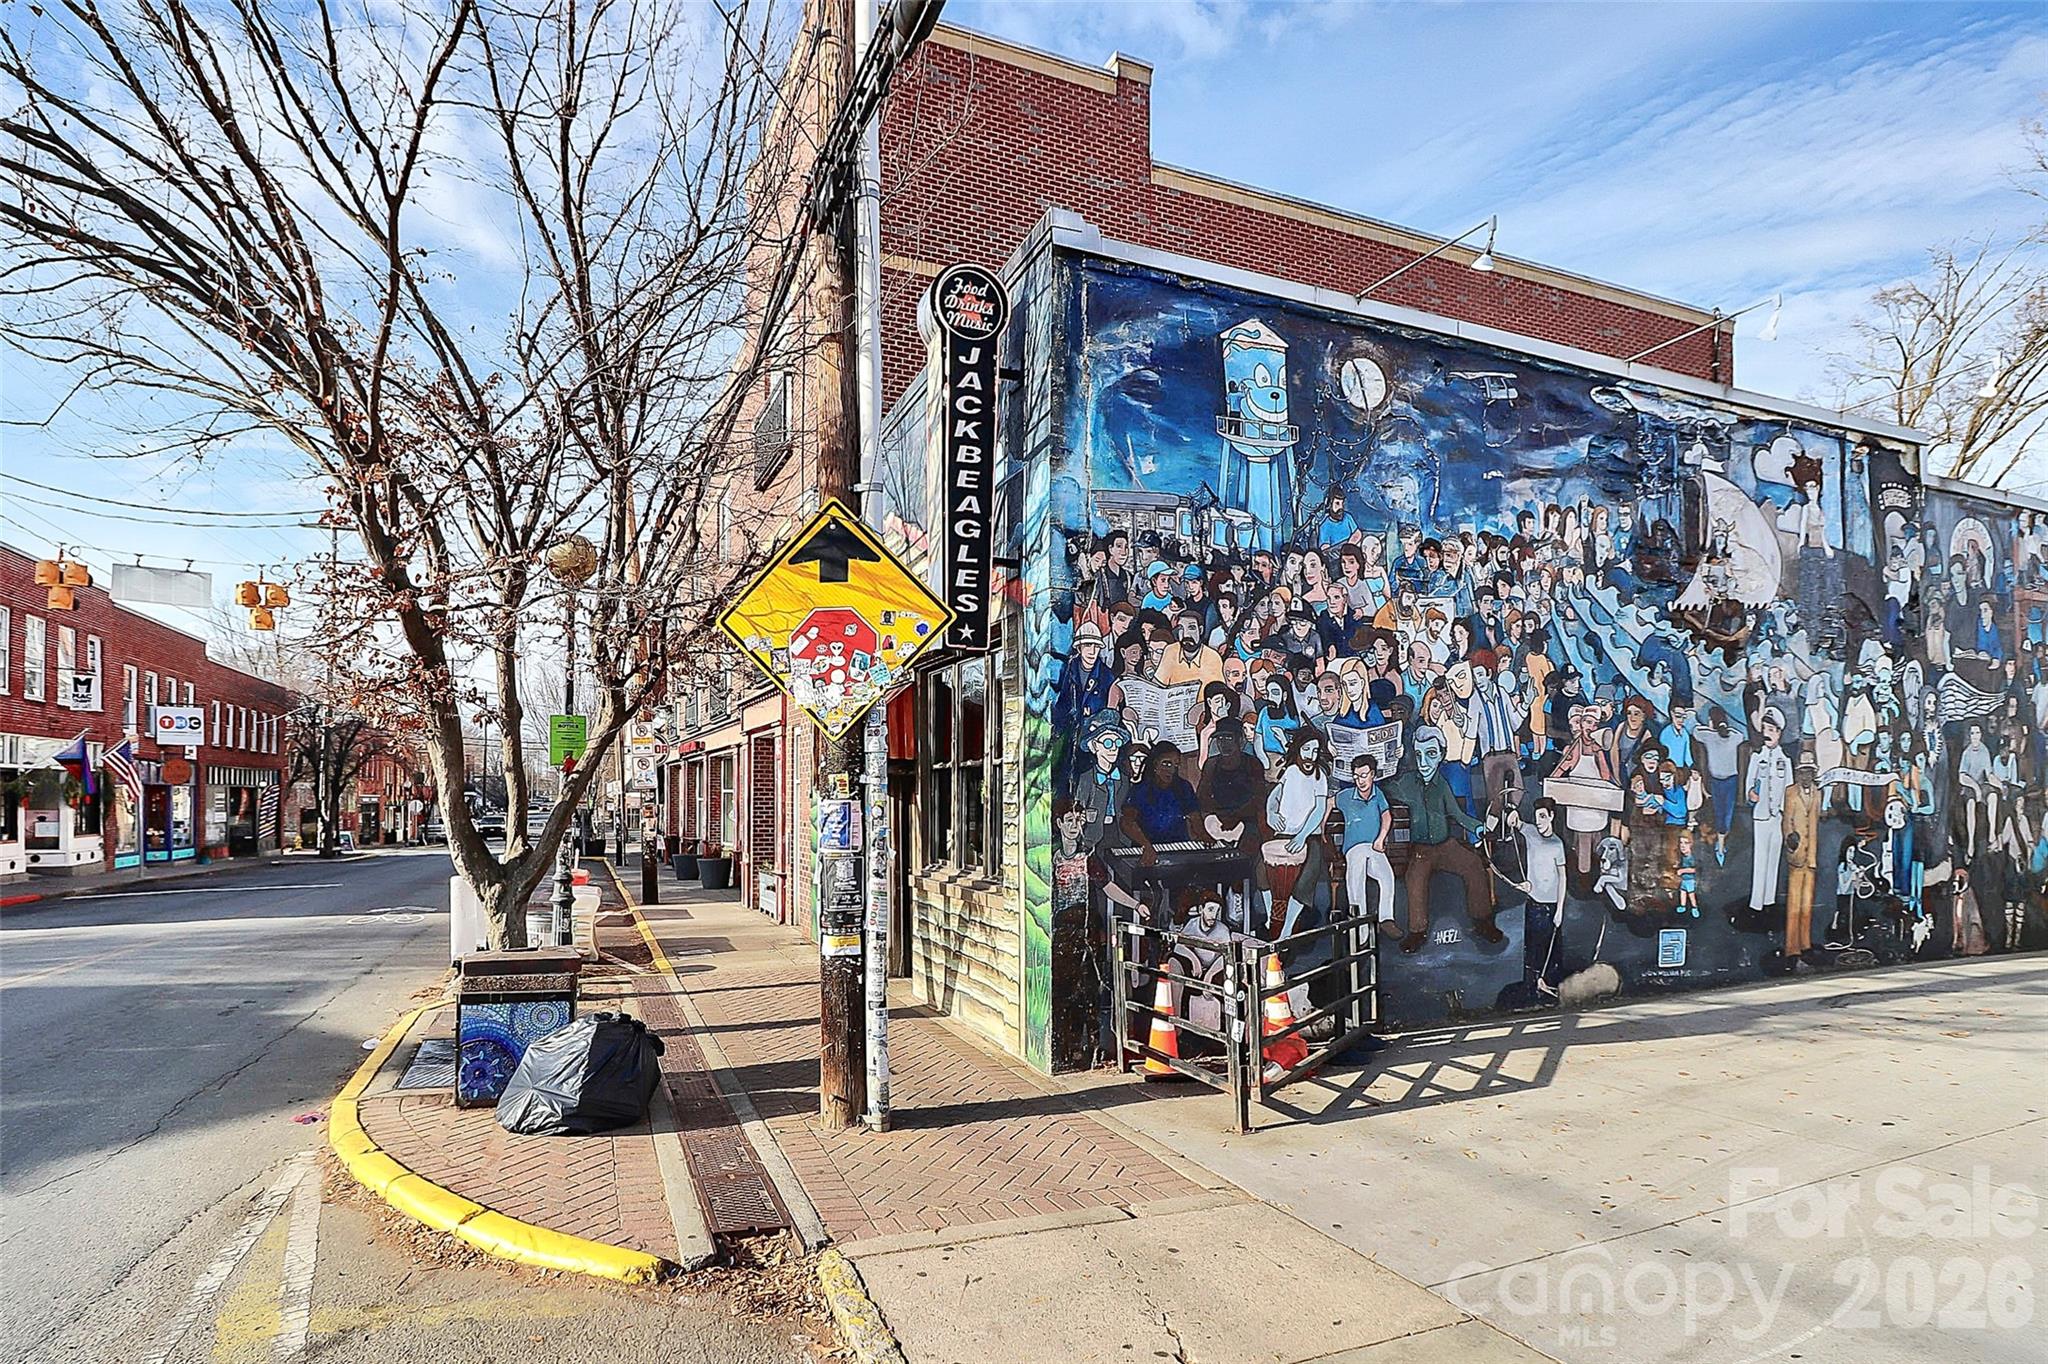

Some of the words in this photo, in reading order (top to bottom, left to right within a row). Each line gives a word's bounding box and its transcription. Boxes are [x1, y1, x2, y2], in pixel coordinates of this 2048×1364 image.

[950, 277, 989, 297] Food
[944, 294, 995, 315] Drinks
[946, 310, 993, 332] Music
[954, 347, 983, 612] JACKBEAGLES
[160, 716, 201, 729] THC
